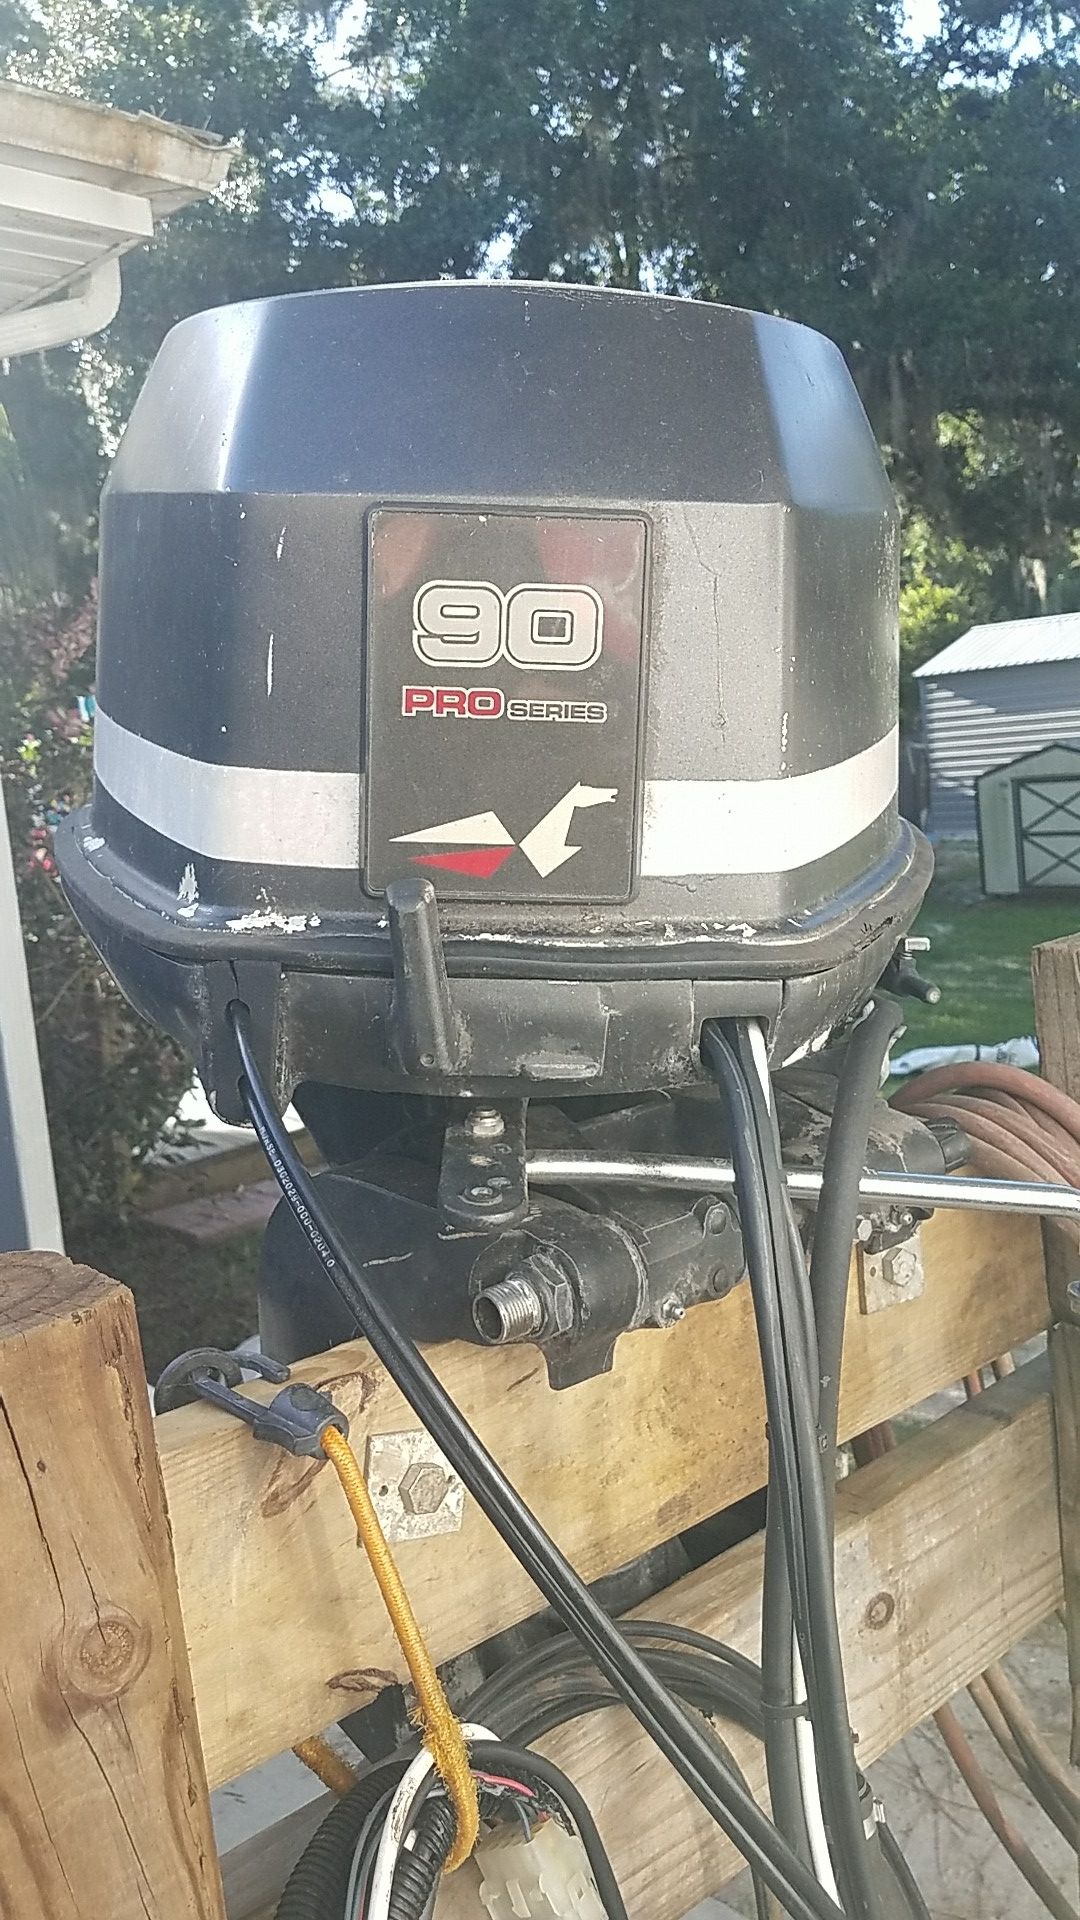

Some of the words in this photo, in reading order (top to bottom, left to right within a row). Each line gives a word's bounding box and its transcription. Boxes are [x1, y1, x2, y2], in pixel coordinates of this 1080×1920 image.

[412, 580, 604, 671] 90
[402, 685, 504, 717] PRO
[507, 700, 608, 723] SERIES
